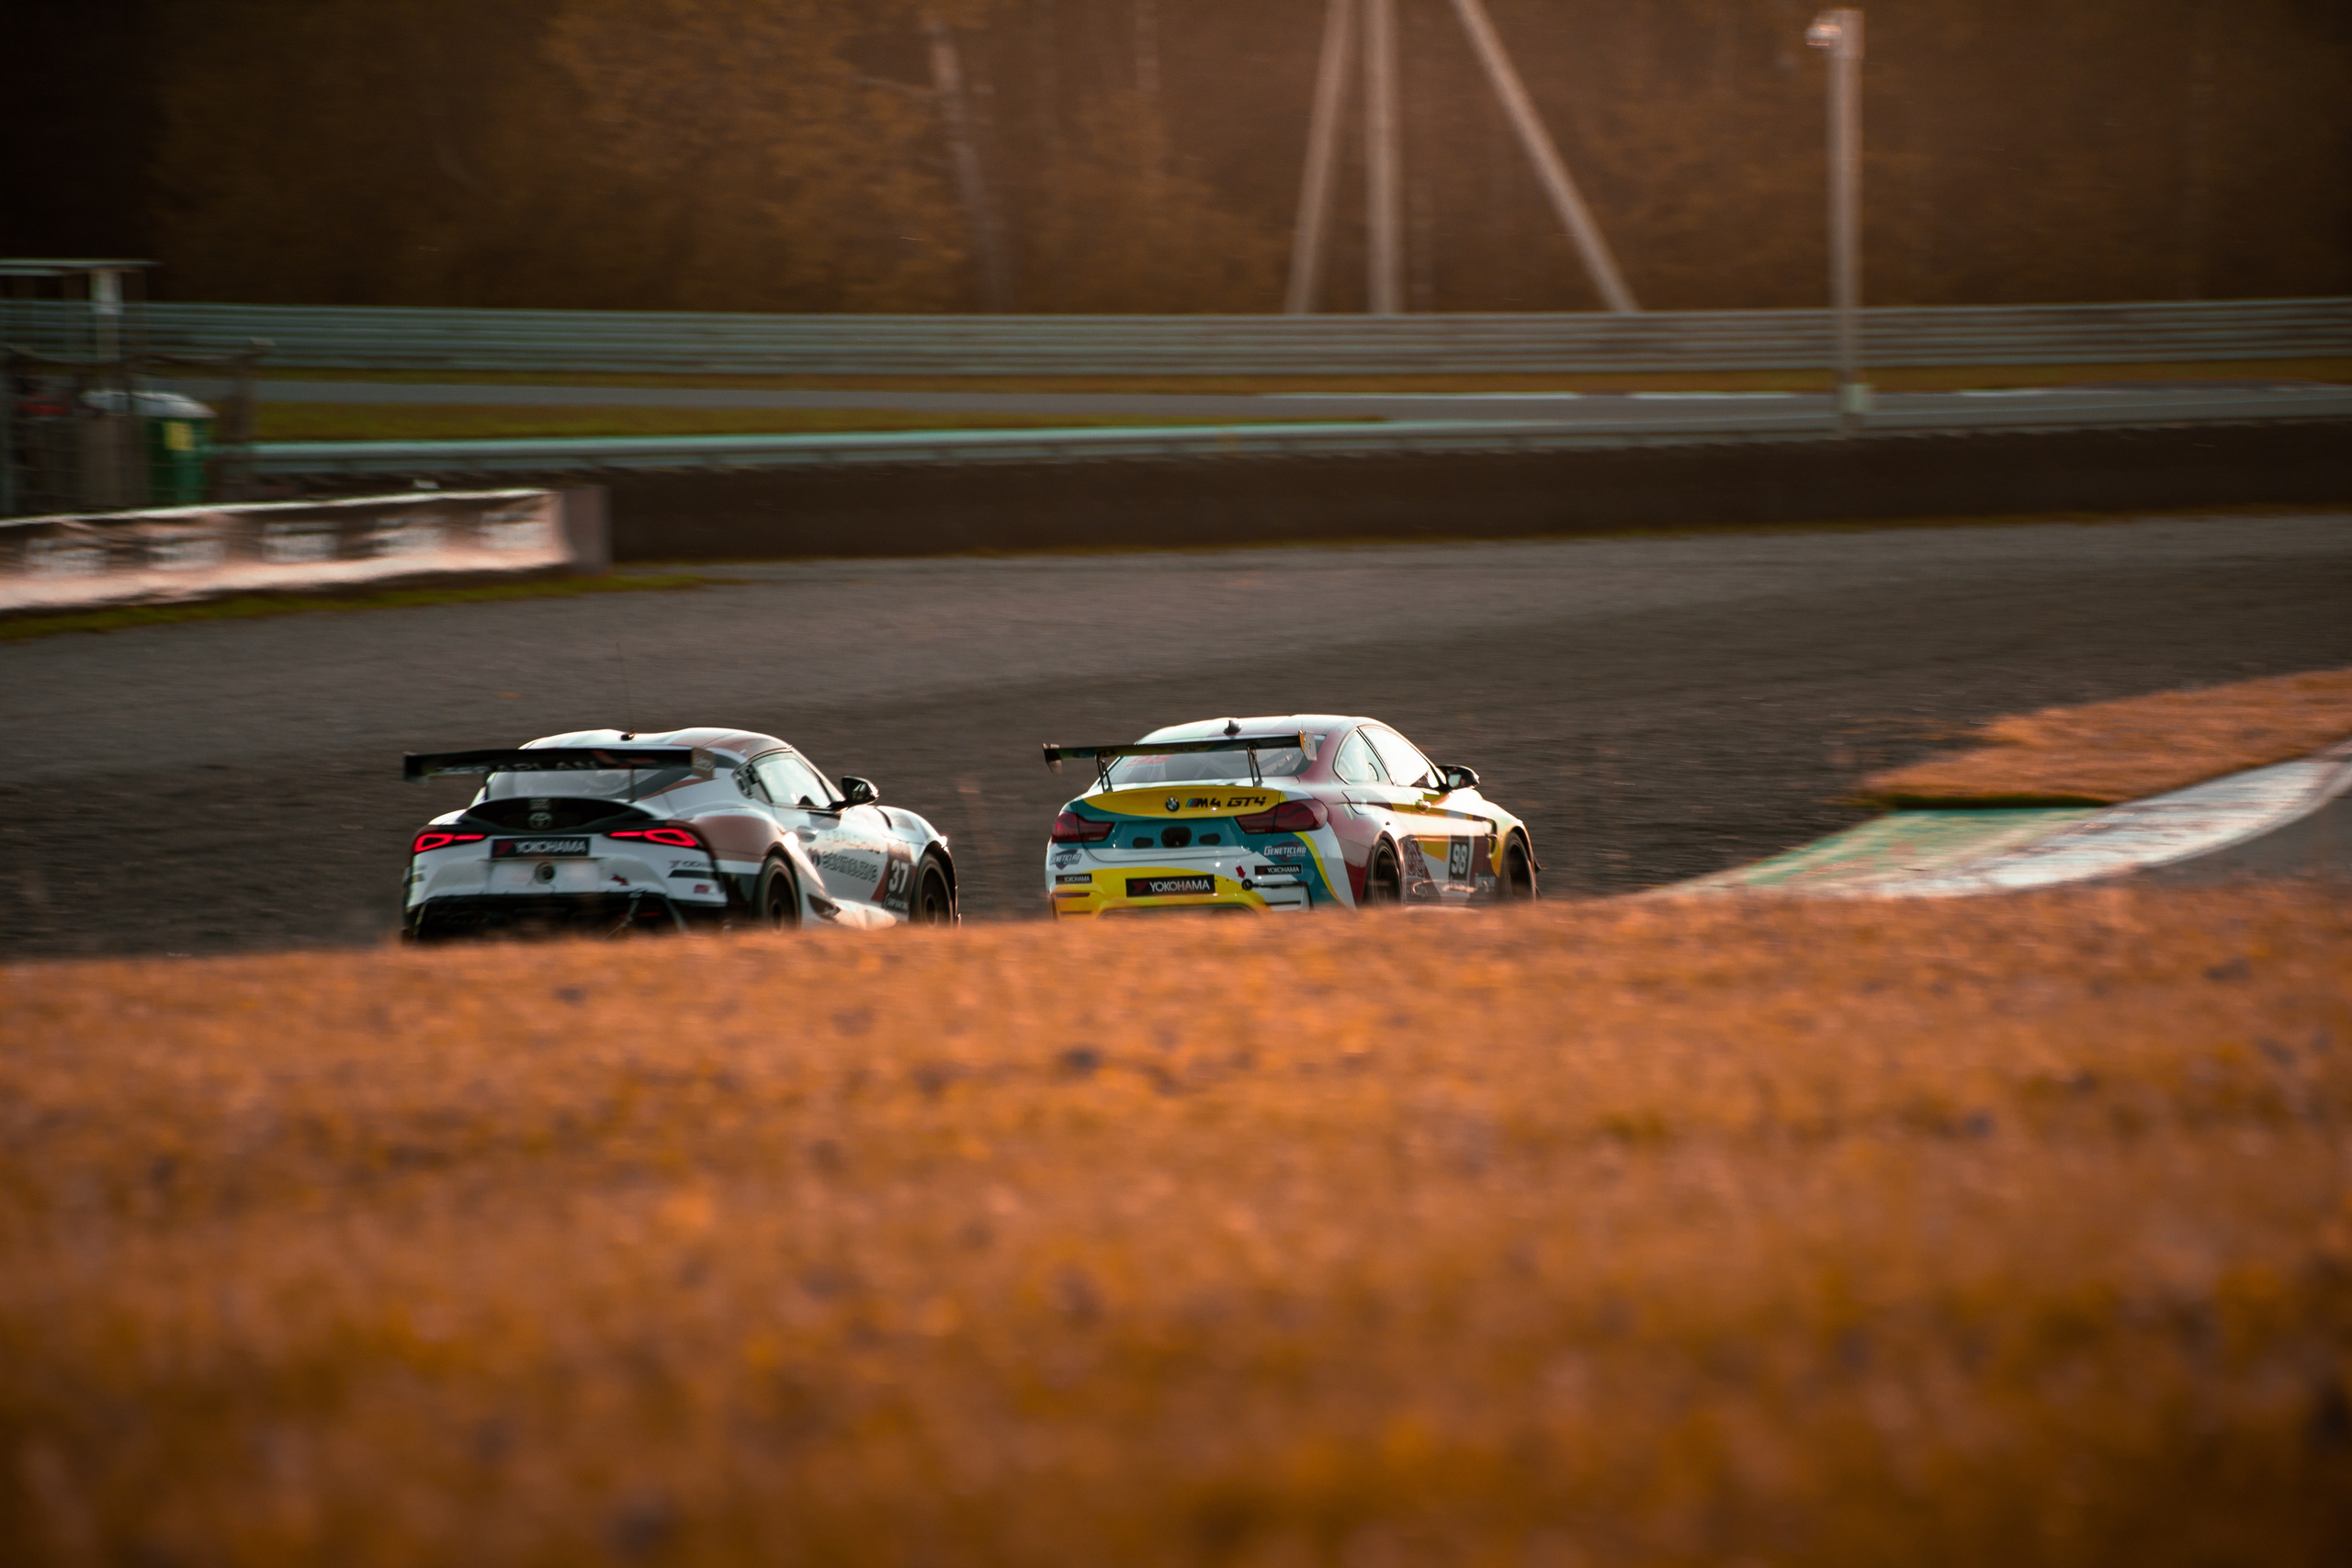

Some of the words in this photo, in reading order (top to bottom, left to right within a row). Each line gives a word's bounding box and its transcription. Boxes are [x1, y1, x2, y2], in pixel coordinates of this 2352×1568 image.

[1227, 796, 1267, 807] GT4
[515, 840, 587, 853] YOKOHAMA
[1452, 844, 1468, 874] 98
[888, 859, 910, 894] 37
[1267, 865, 1300, 874] YOKOHAMA
[1149, 878, 1211, 893] YOKOHAMA
